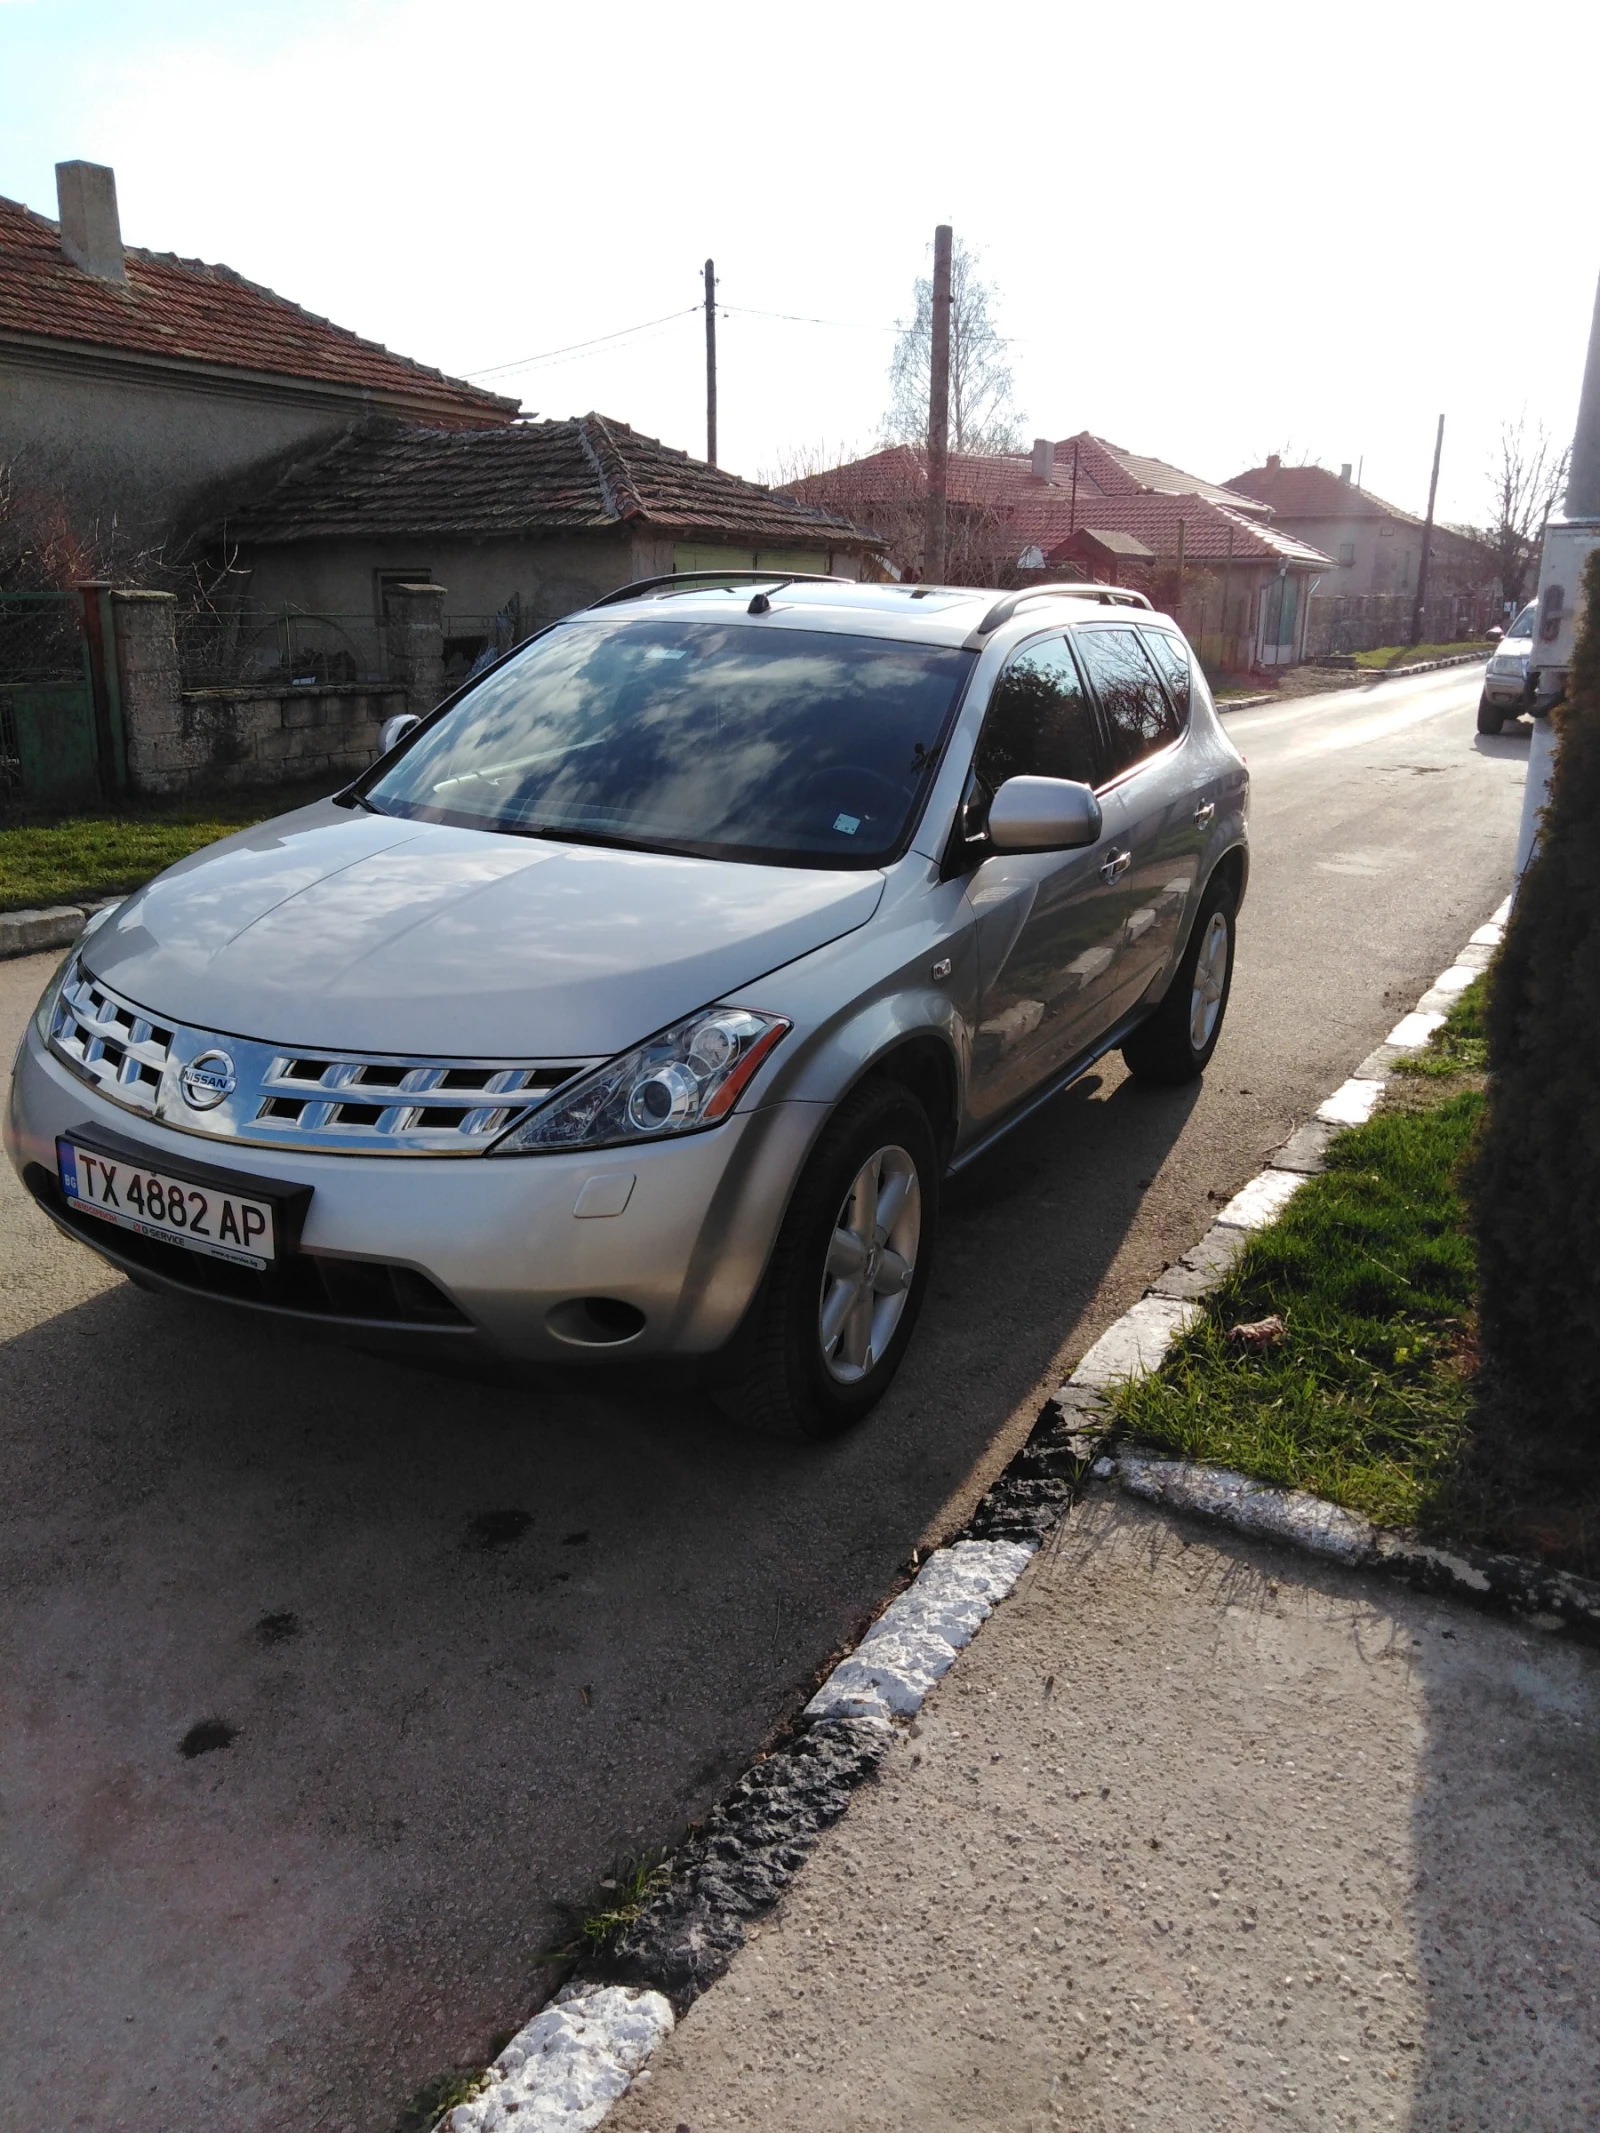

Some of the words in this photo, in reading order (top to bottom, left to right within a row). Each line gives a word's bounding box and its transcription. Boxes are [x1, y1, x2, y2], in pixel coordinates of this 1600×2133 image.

[183, 1070, 227, 1088] NISSAN
[64, 1173, 76, 1188] BG
[79, 1154, 120, 1207] TX
[127, 1174, 209, 1235] 4882
[219, 1200, 266, 1247] AP
[149, 1228, 185, 1246] SERVICE
